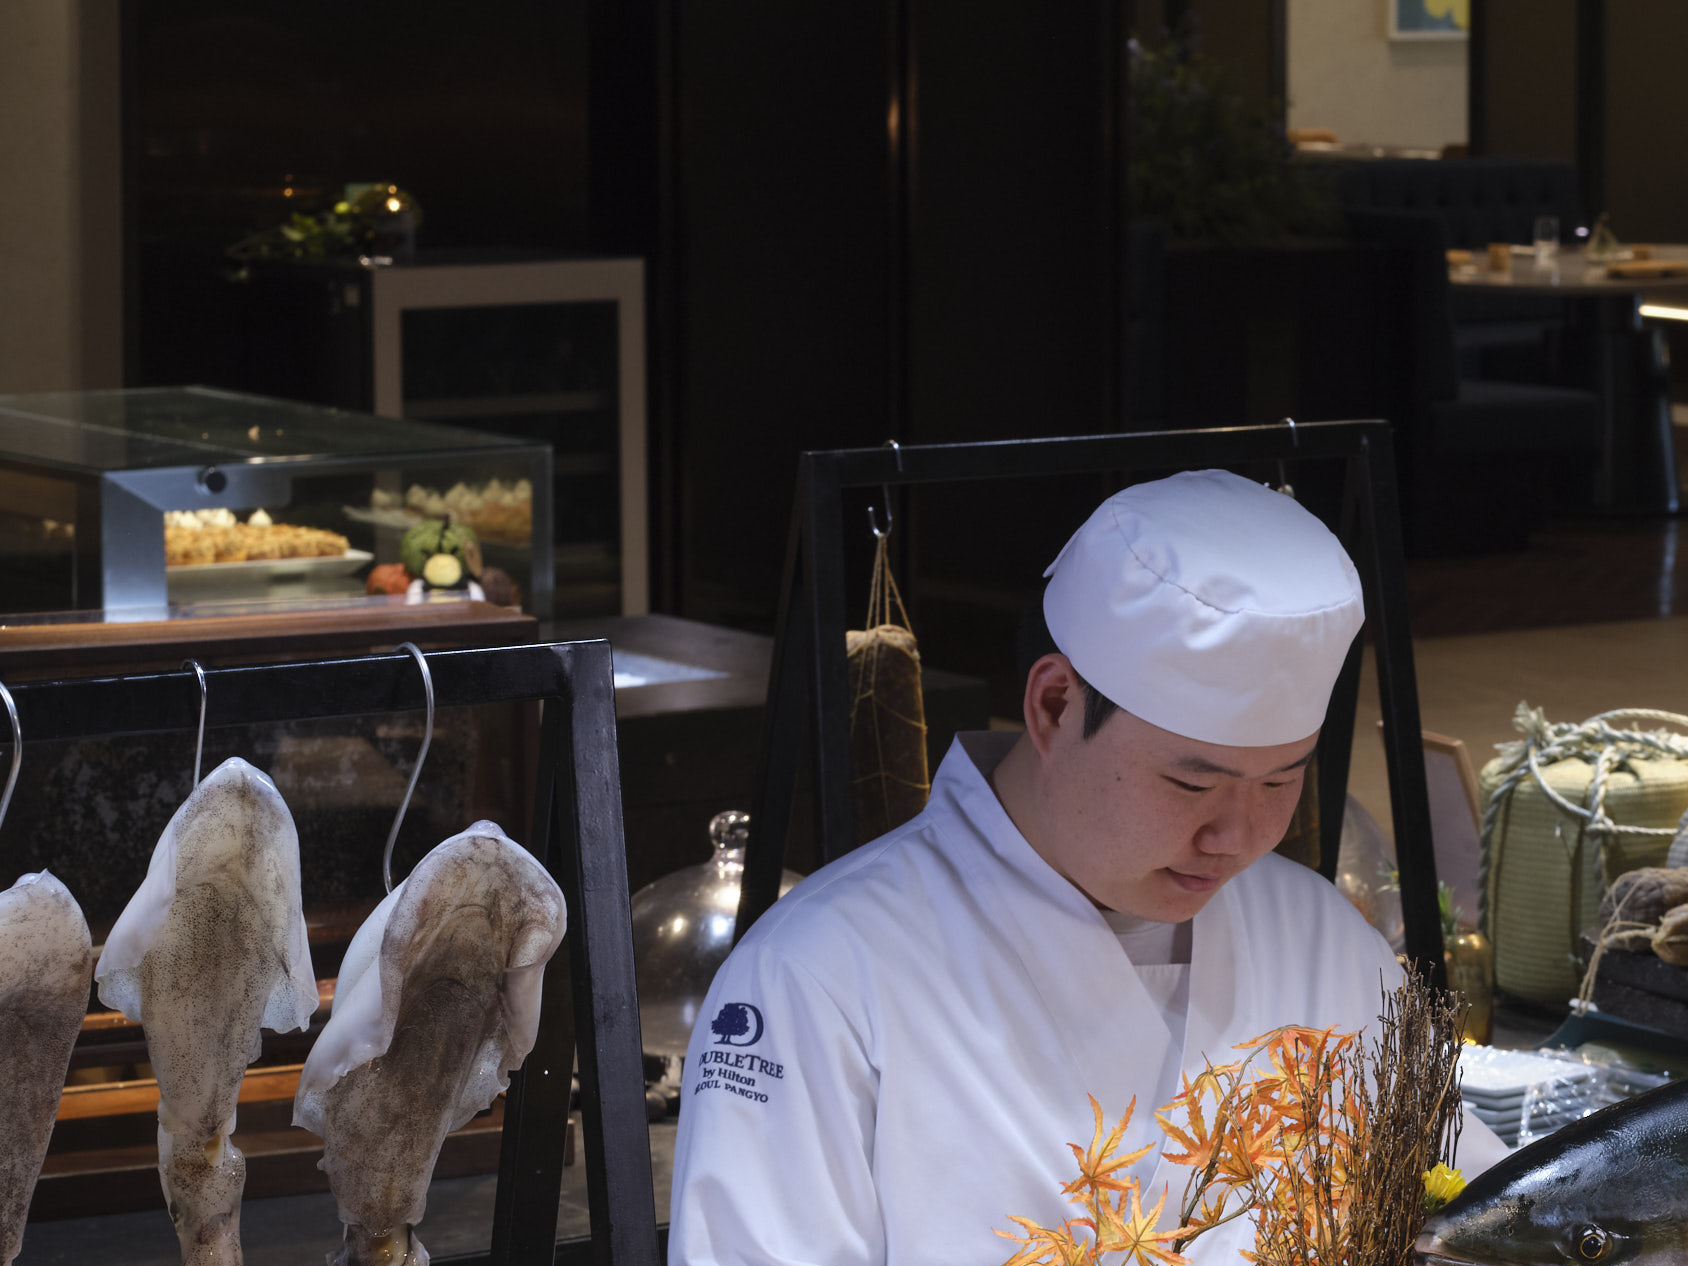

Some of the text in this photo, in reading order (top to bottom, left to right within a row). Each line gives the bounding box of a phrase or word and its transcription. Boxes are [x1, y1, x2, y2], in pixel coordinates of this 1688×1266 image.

[703, 1067, 756, 1087] by Hilton
[724, 1083, 769, 1103] PANGYO
